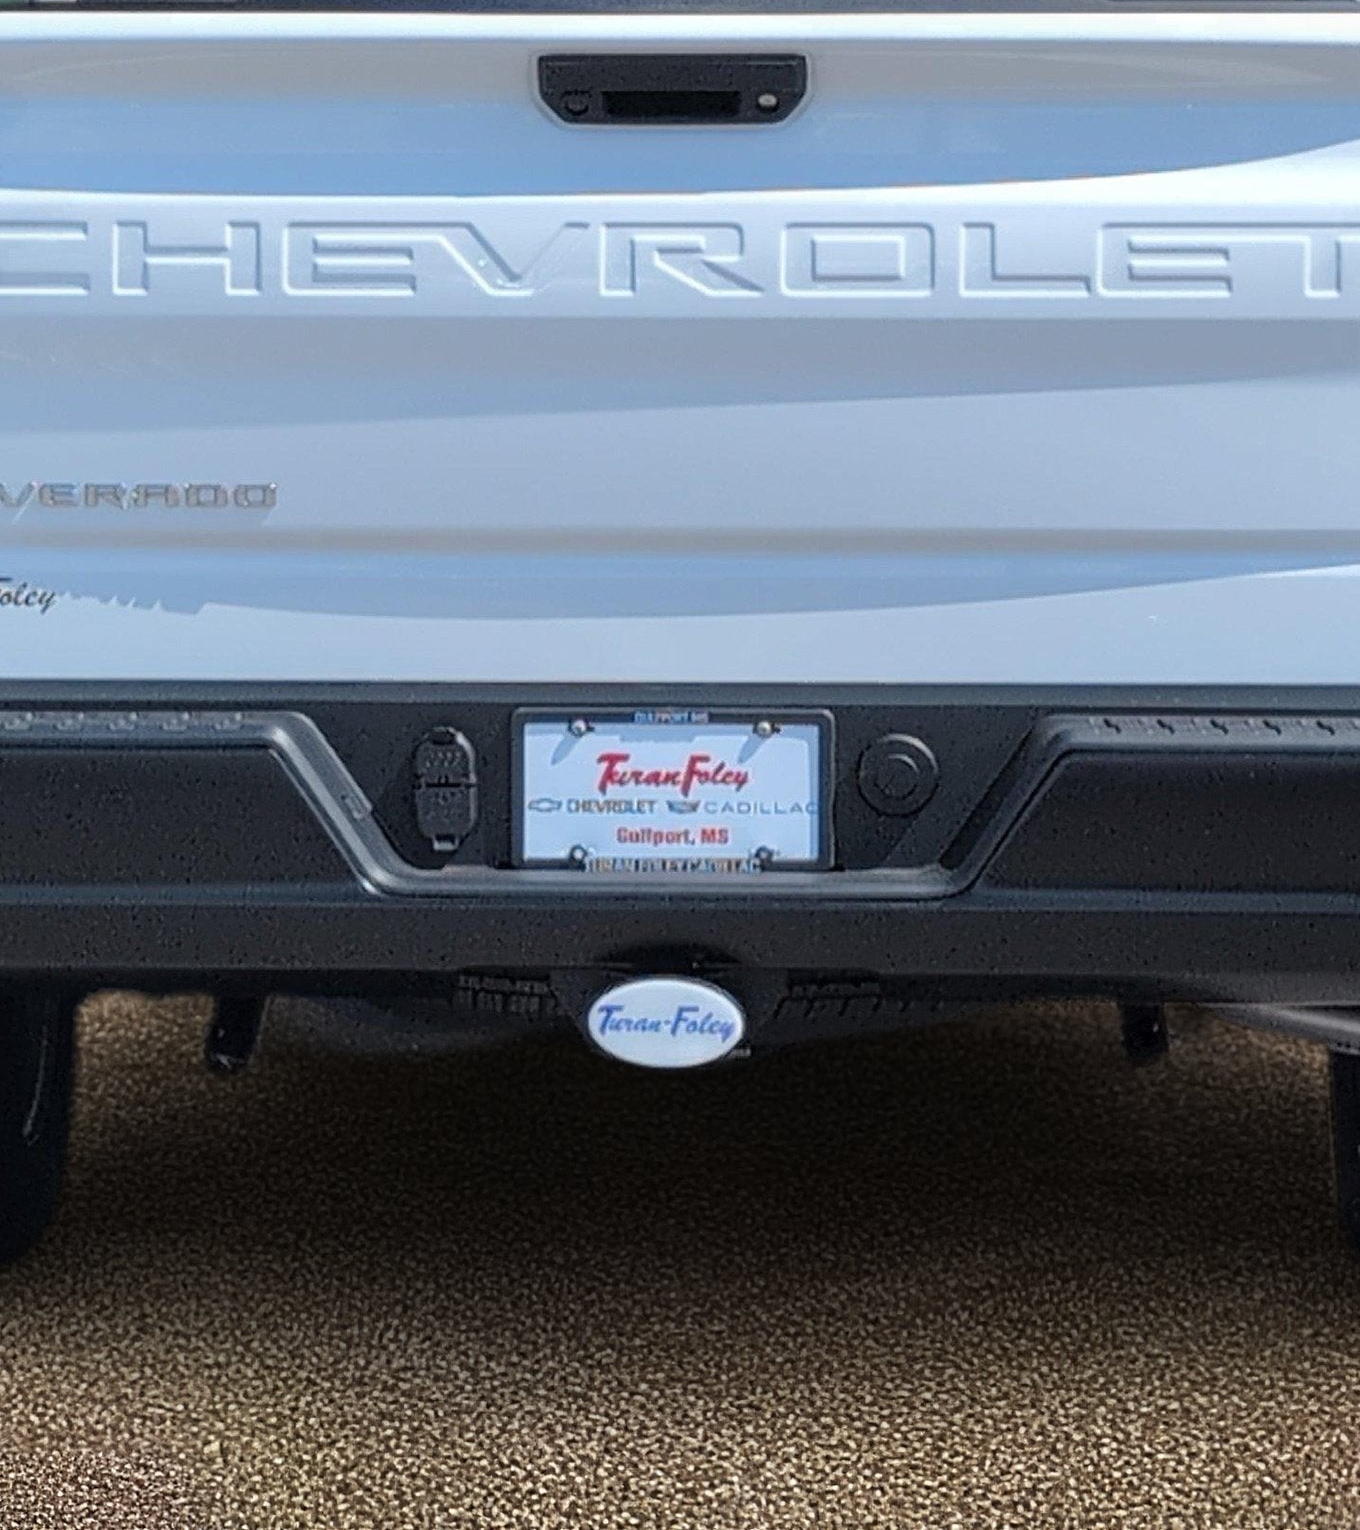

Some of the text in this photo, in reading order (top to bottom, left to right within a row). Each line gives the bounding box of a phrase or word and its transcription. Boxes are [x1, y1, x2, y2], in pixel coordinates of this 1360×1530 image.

[566, 799, 819, 815] CHEVROLET CADILLAC
[616, 826, 730, 846] Gulfport, MS
